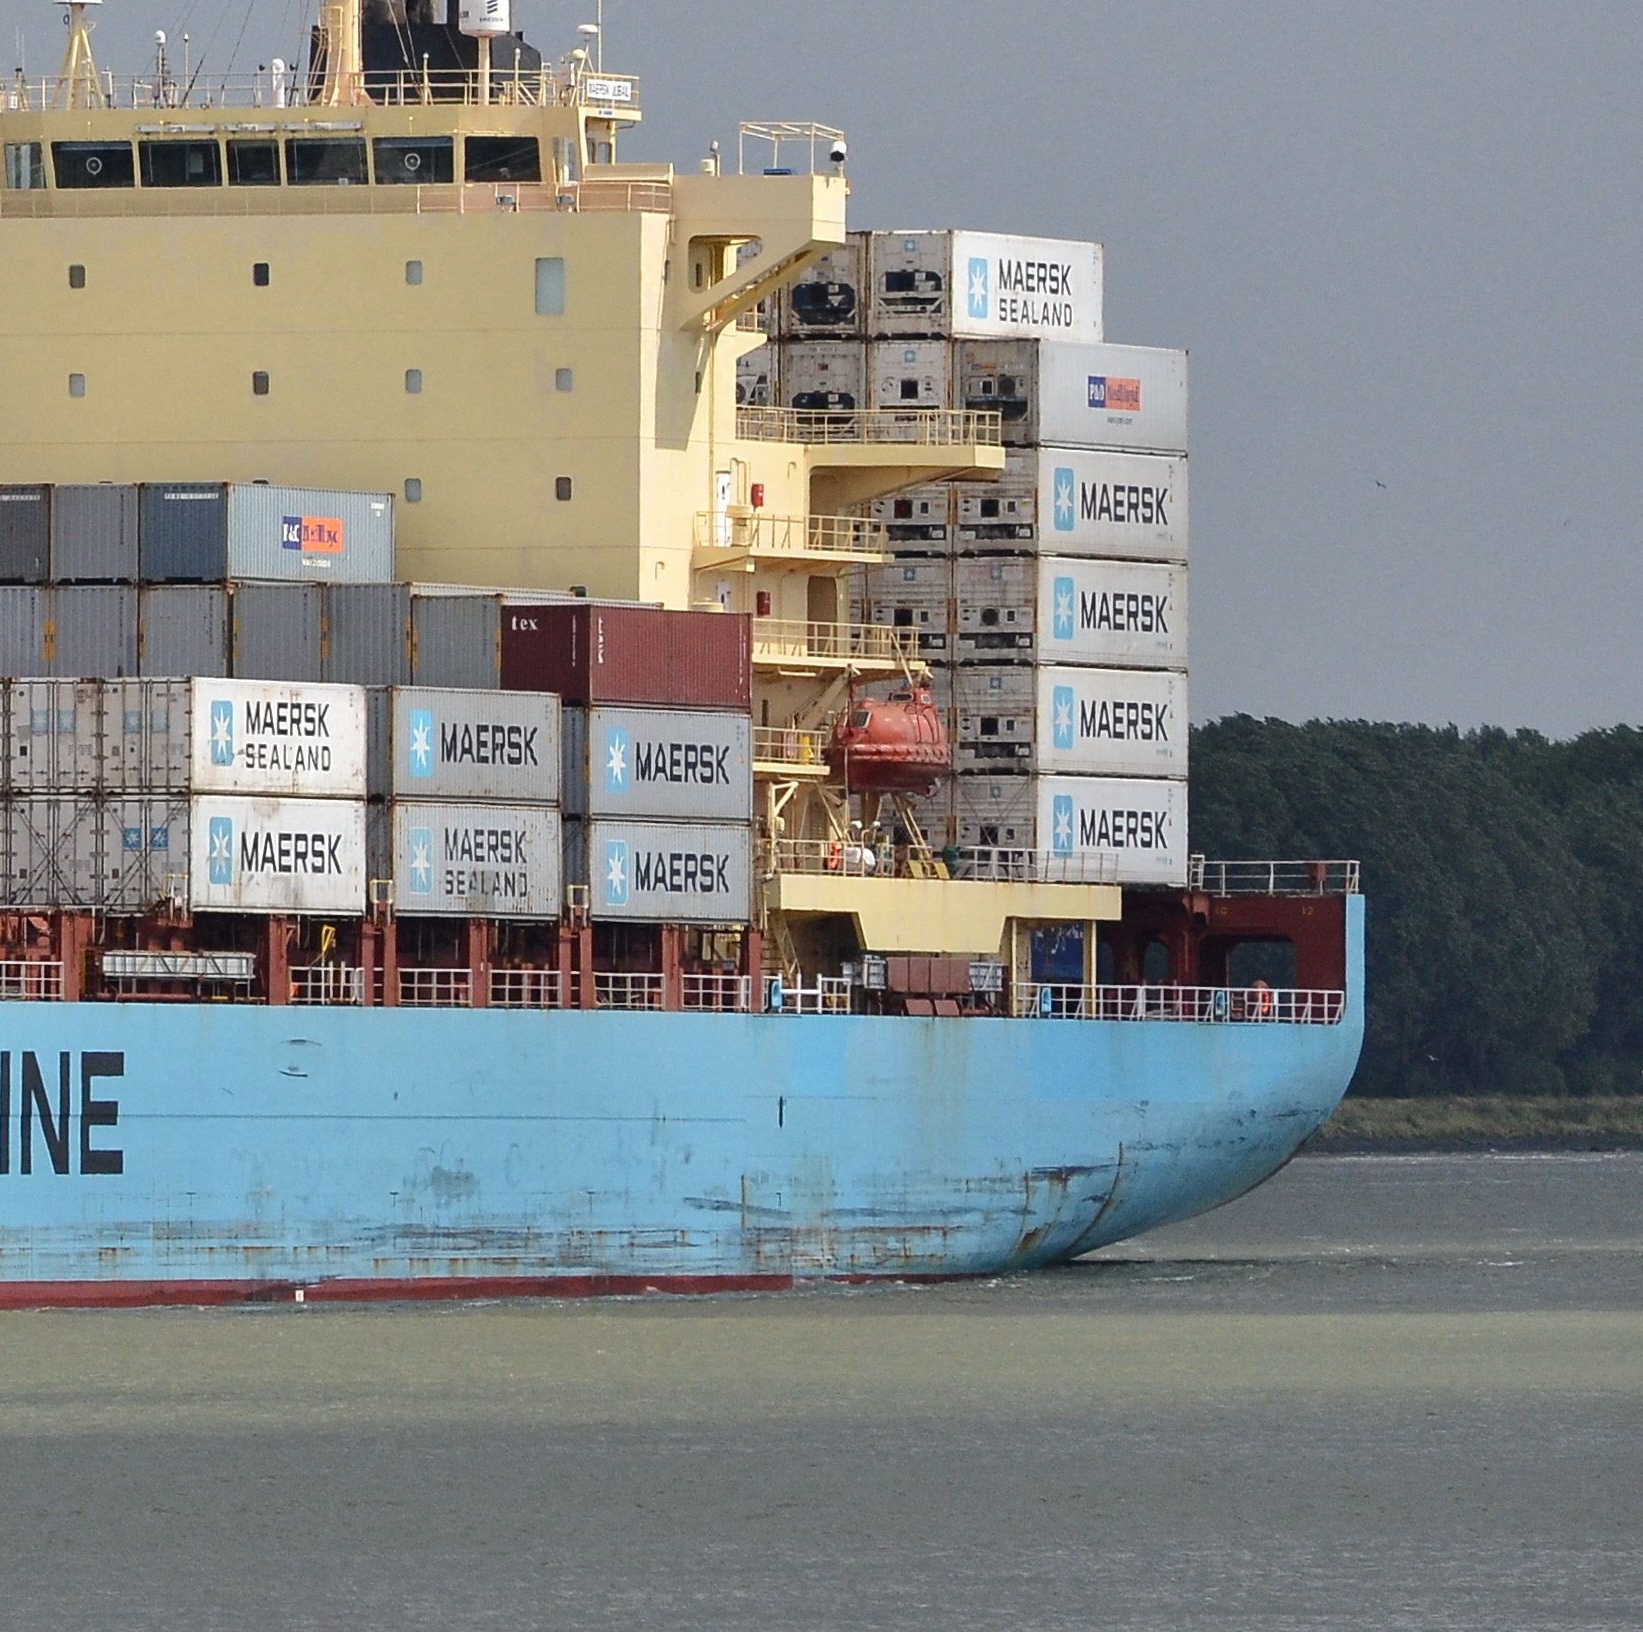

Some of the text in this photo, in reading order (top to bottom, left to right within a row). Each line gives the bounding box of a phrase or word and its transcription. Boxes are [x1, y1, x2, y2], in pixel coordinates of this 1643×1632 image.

[999, 259, 1071, 295] MAERSK
[999, 298, 1072, 327] SEALAND
[1082, 482, 1168, 525] MAERSK
[512, 616, 538, 631] tex
[1081, 591, 1168, 633] MAERSK
[246, 701, 329, 737] MAERSK
[1081, 700, 1168, 741] MAERSK
[246, 744, 330, 771] SEALAND
[442, 723, 537, 766] MAERSK
[636, 742, 729, 784] MAERSK
[445, 828, 527, 863] MAERSK
[1081, 809, 1167, 848] MAERSK
[241, 832, 341, 874] MAERSK
[636, 852, 729, 893] MAERSK
